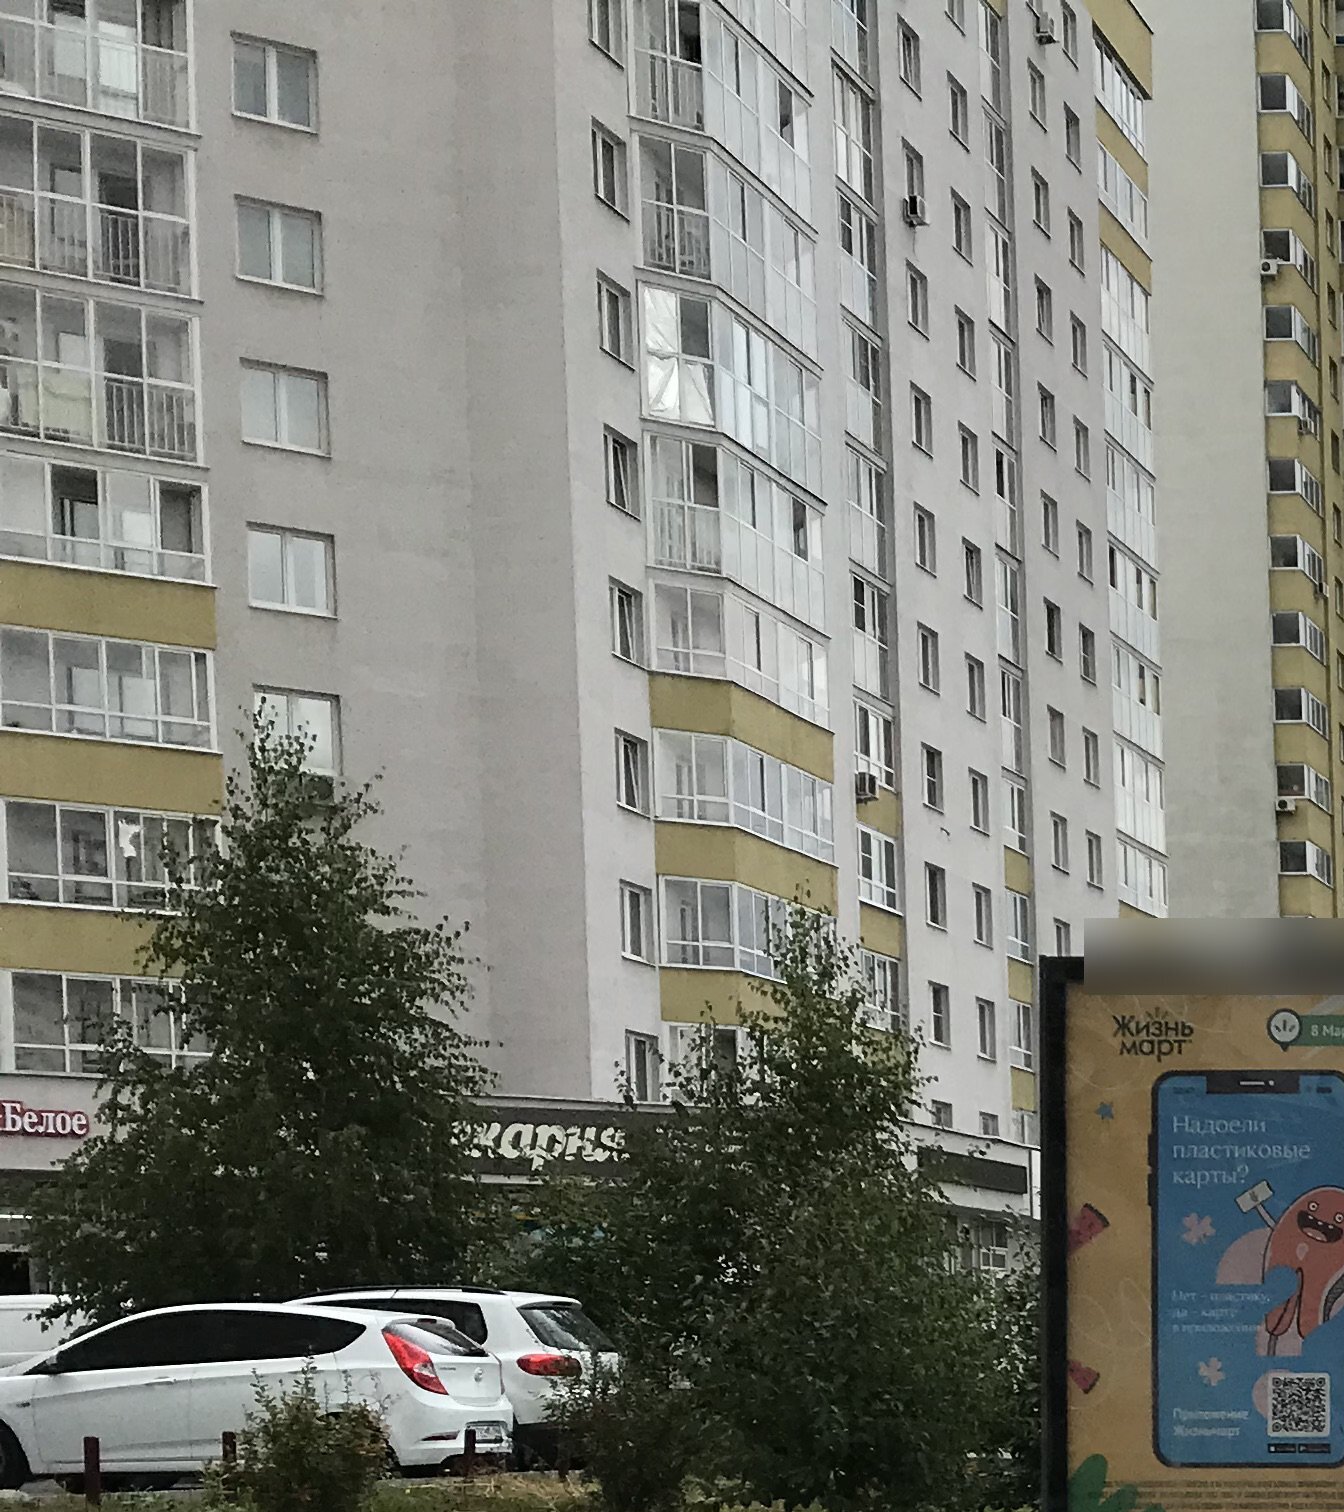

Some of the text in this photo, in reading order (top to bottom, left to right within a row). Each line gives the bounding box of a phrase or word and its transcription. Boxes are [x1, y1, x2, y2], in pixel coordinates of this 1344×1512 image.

[1112, 1015, 1194, 1037] Жизнь
[1311, 1024, 1319, 1037] 8
[1119, 1039, 1187, 1063] март
[1, 1102, 87, 1135] Белое
[1172, 1115, 1266, 1135] Надоели
[1172, 1143, 1311, 1159] пластиковые
[1172, 1164, 1249, 1189] карты?
